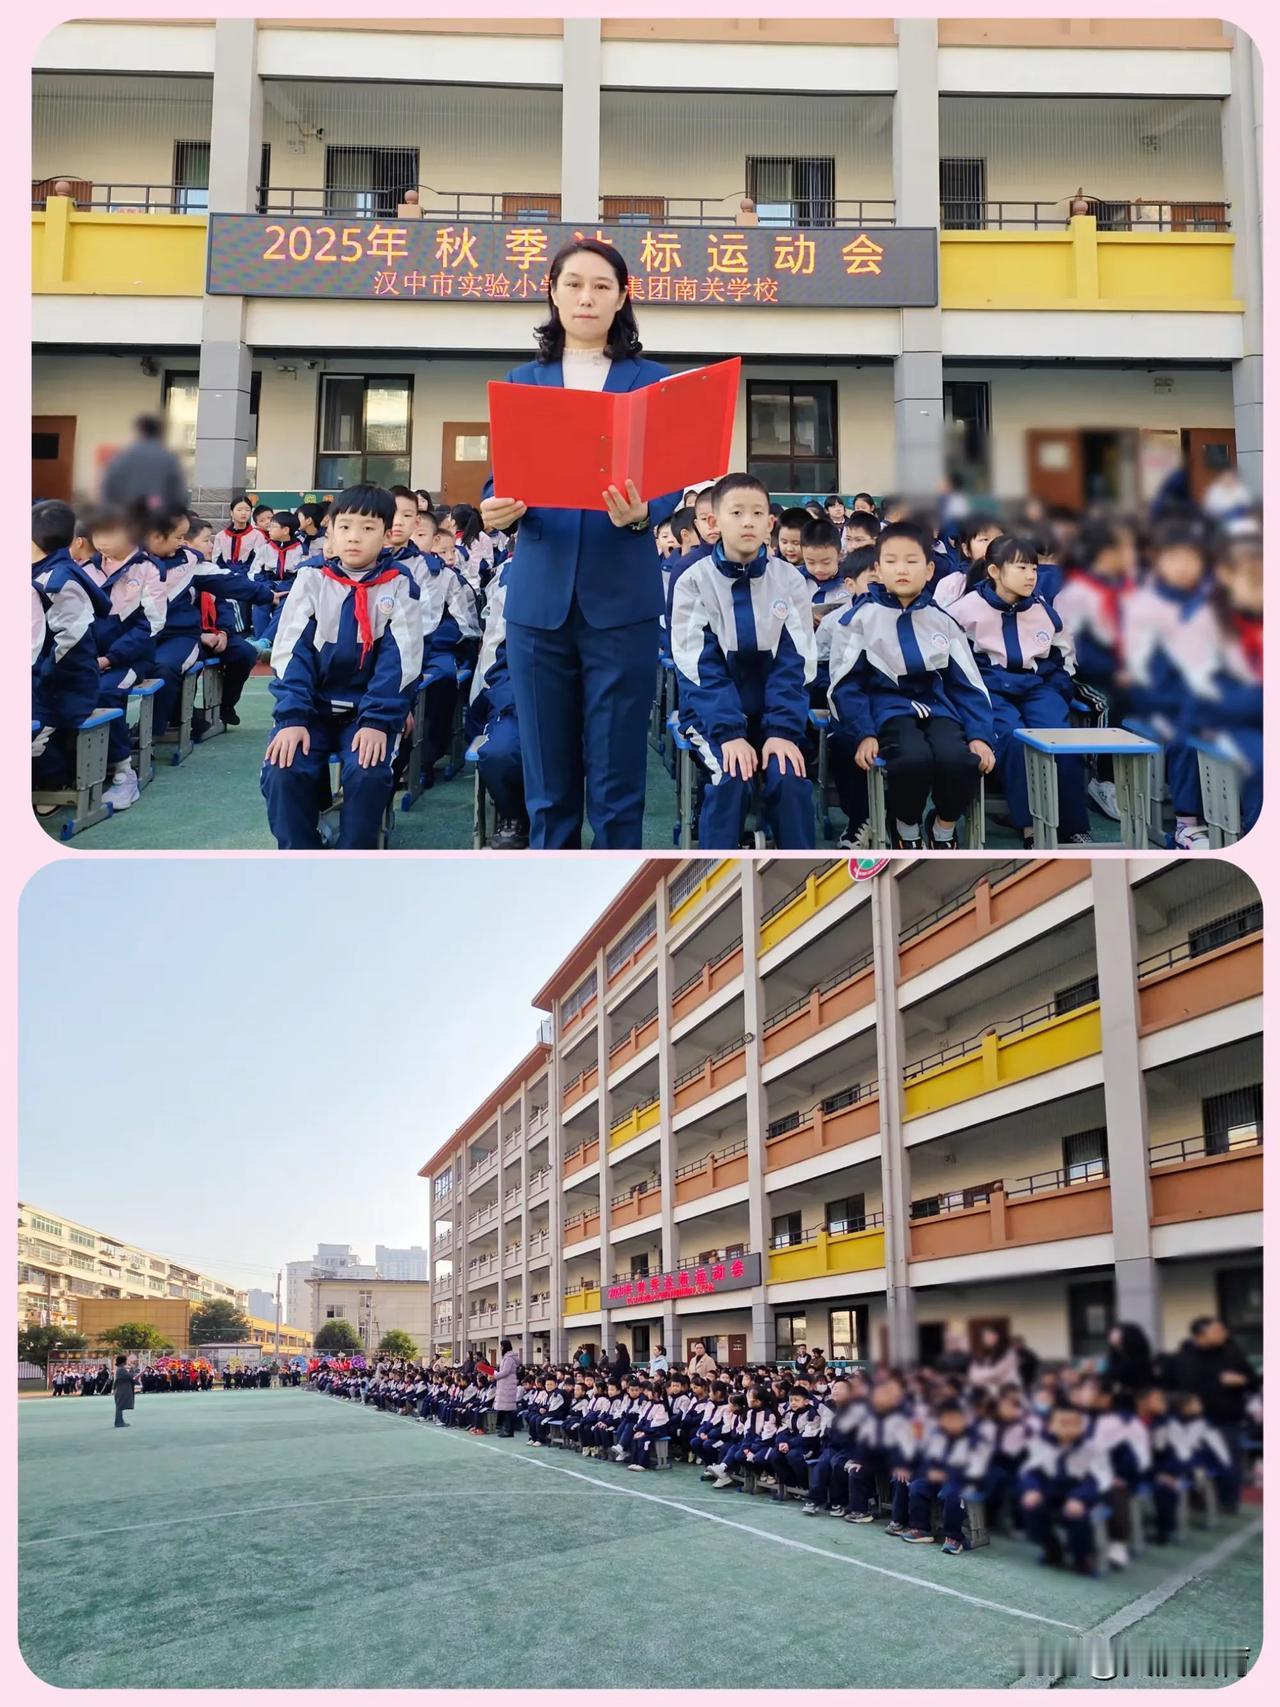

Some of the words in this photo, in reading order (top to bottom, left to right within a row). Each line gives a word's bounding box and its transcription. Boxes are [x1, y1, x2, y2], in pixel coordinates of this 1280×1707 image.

[373, 271, 779, 303] 汉中市实验小集团南关学校
